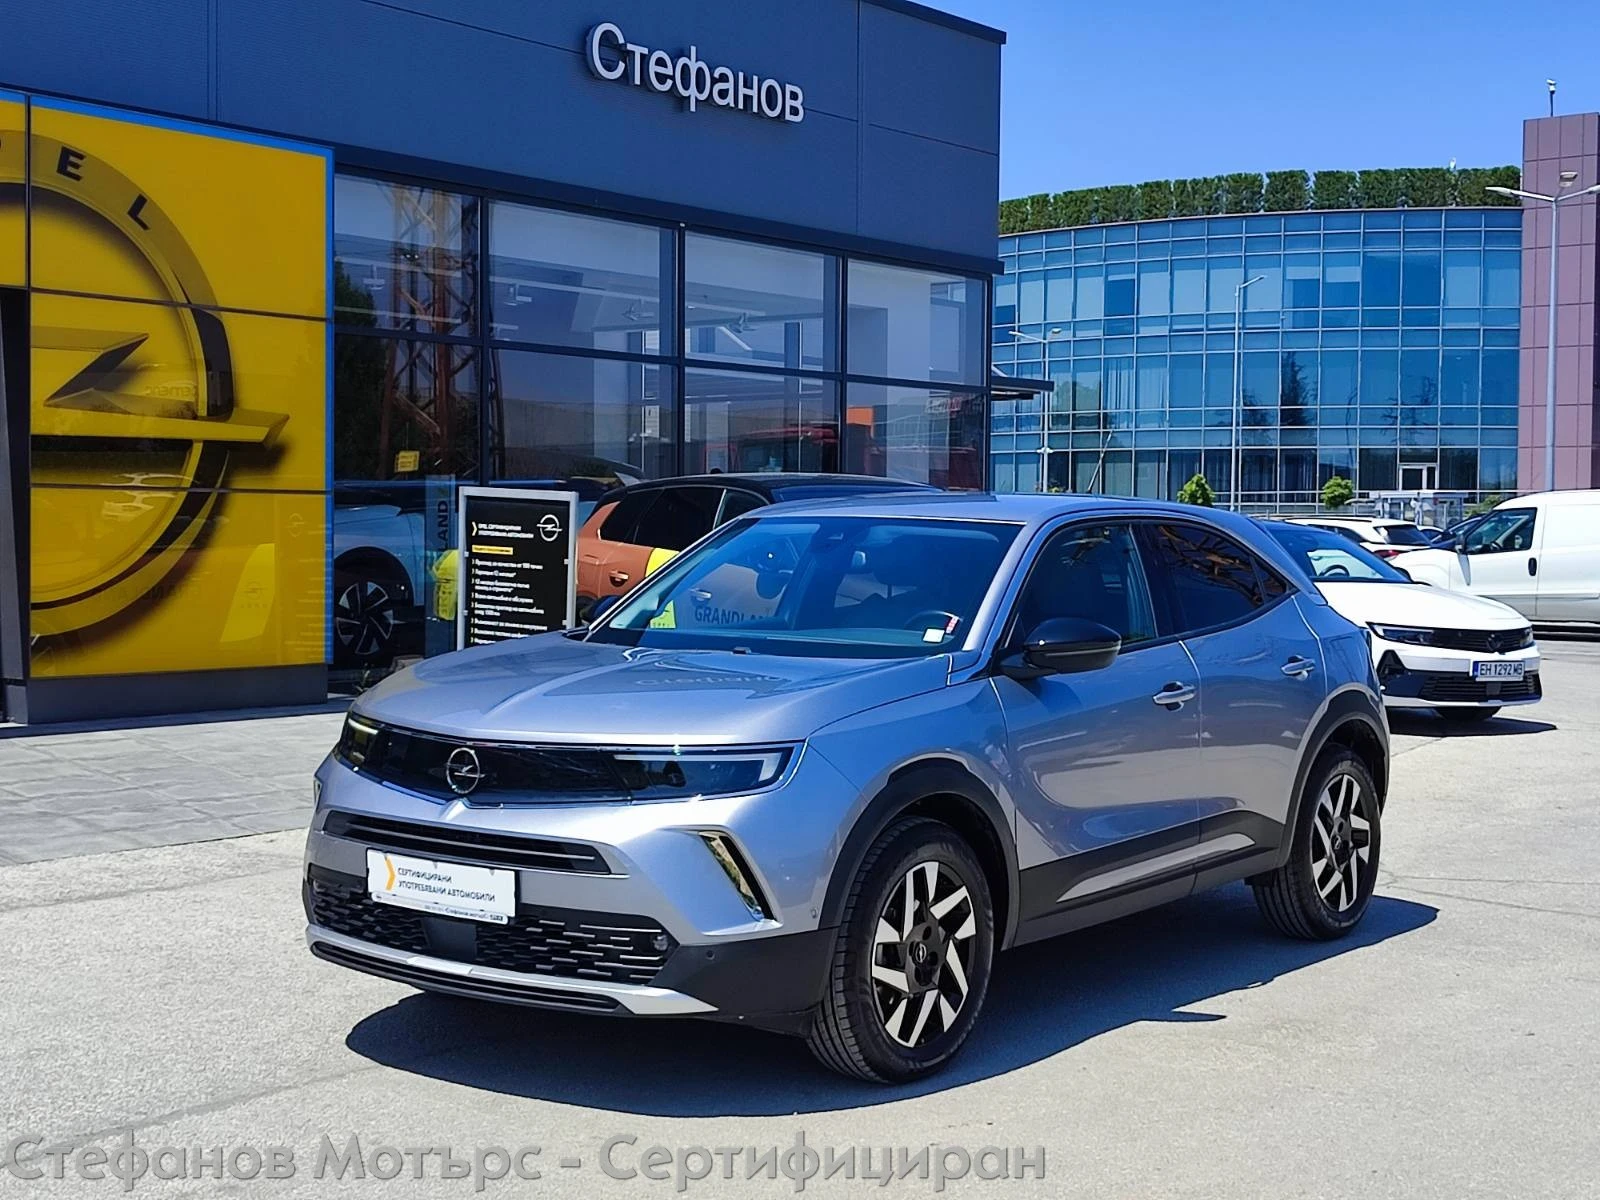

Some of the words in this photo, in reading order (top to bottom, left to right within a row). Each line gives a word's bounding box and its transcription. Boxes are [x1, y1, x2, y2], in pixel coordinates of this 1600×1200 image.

[590, 22, 805, 123] Стефанов
[1480, 663, 1492, 676] EH
[1494, 663, 1512, 676] 1292
[397, 867, 452, 883] СЕРТИФИЦИРАНИ
[398, 880, 447, 895] УПОТРЕБЯВАНИ
[447, 888, 496, 902] АВТОМОБИЛИ
